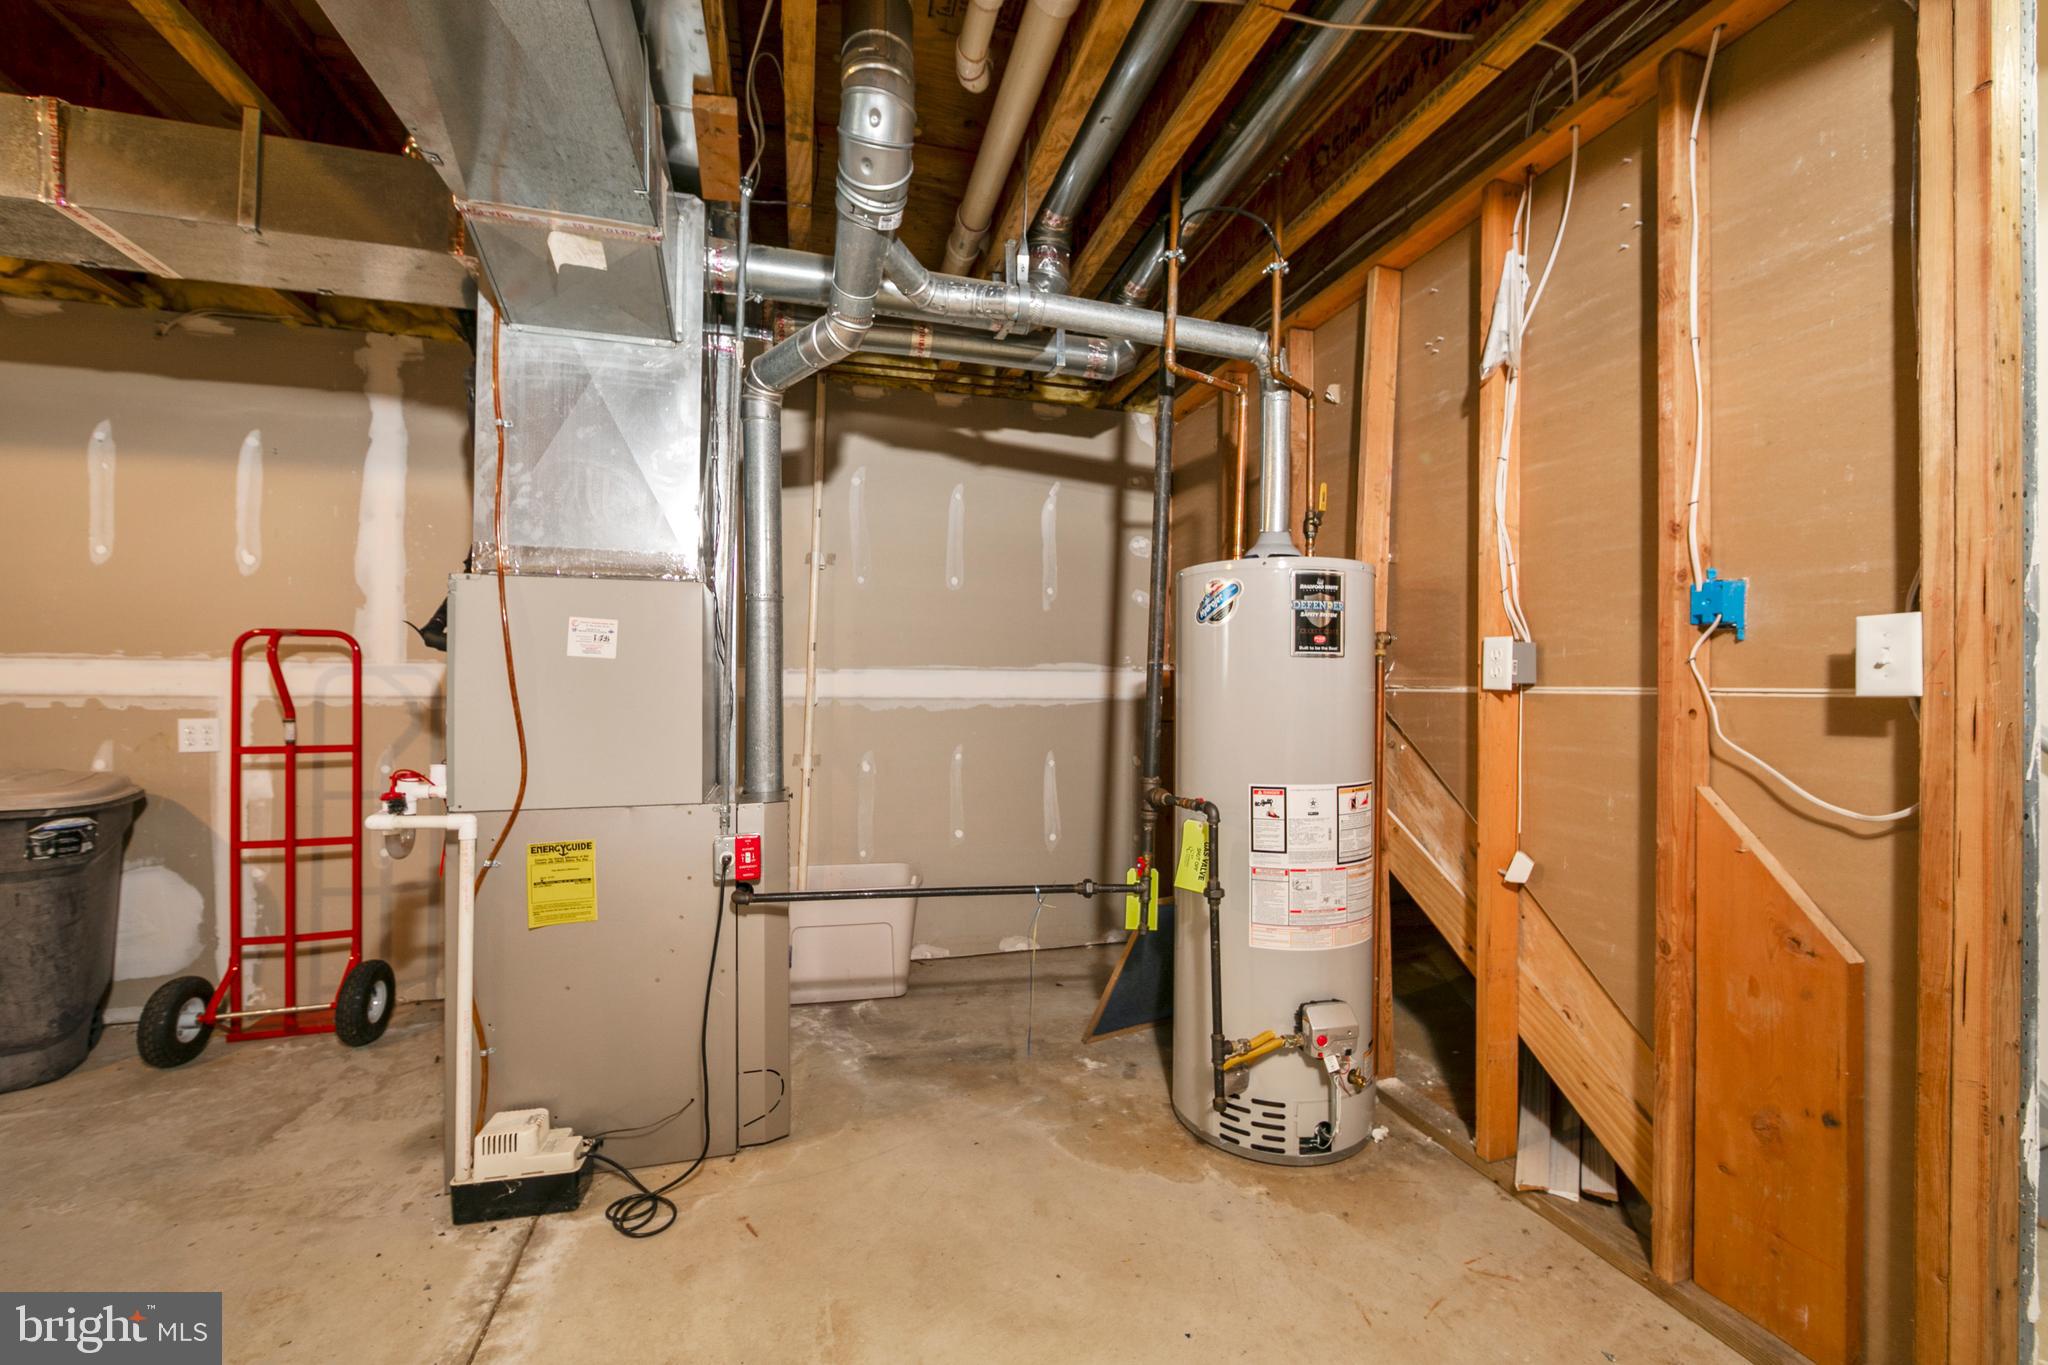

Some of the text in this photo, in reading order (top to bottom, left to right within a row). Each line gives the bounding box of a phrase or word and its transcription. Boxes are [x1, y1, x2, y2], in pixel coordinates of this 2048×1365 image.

[1292, 600, 1345, 612] DEFENDER
[530, 842, 593, 856] ENERGYGUIDE
[1198, 859, 1208, 881] VALVE
